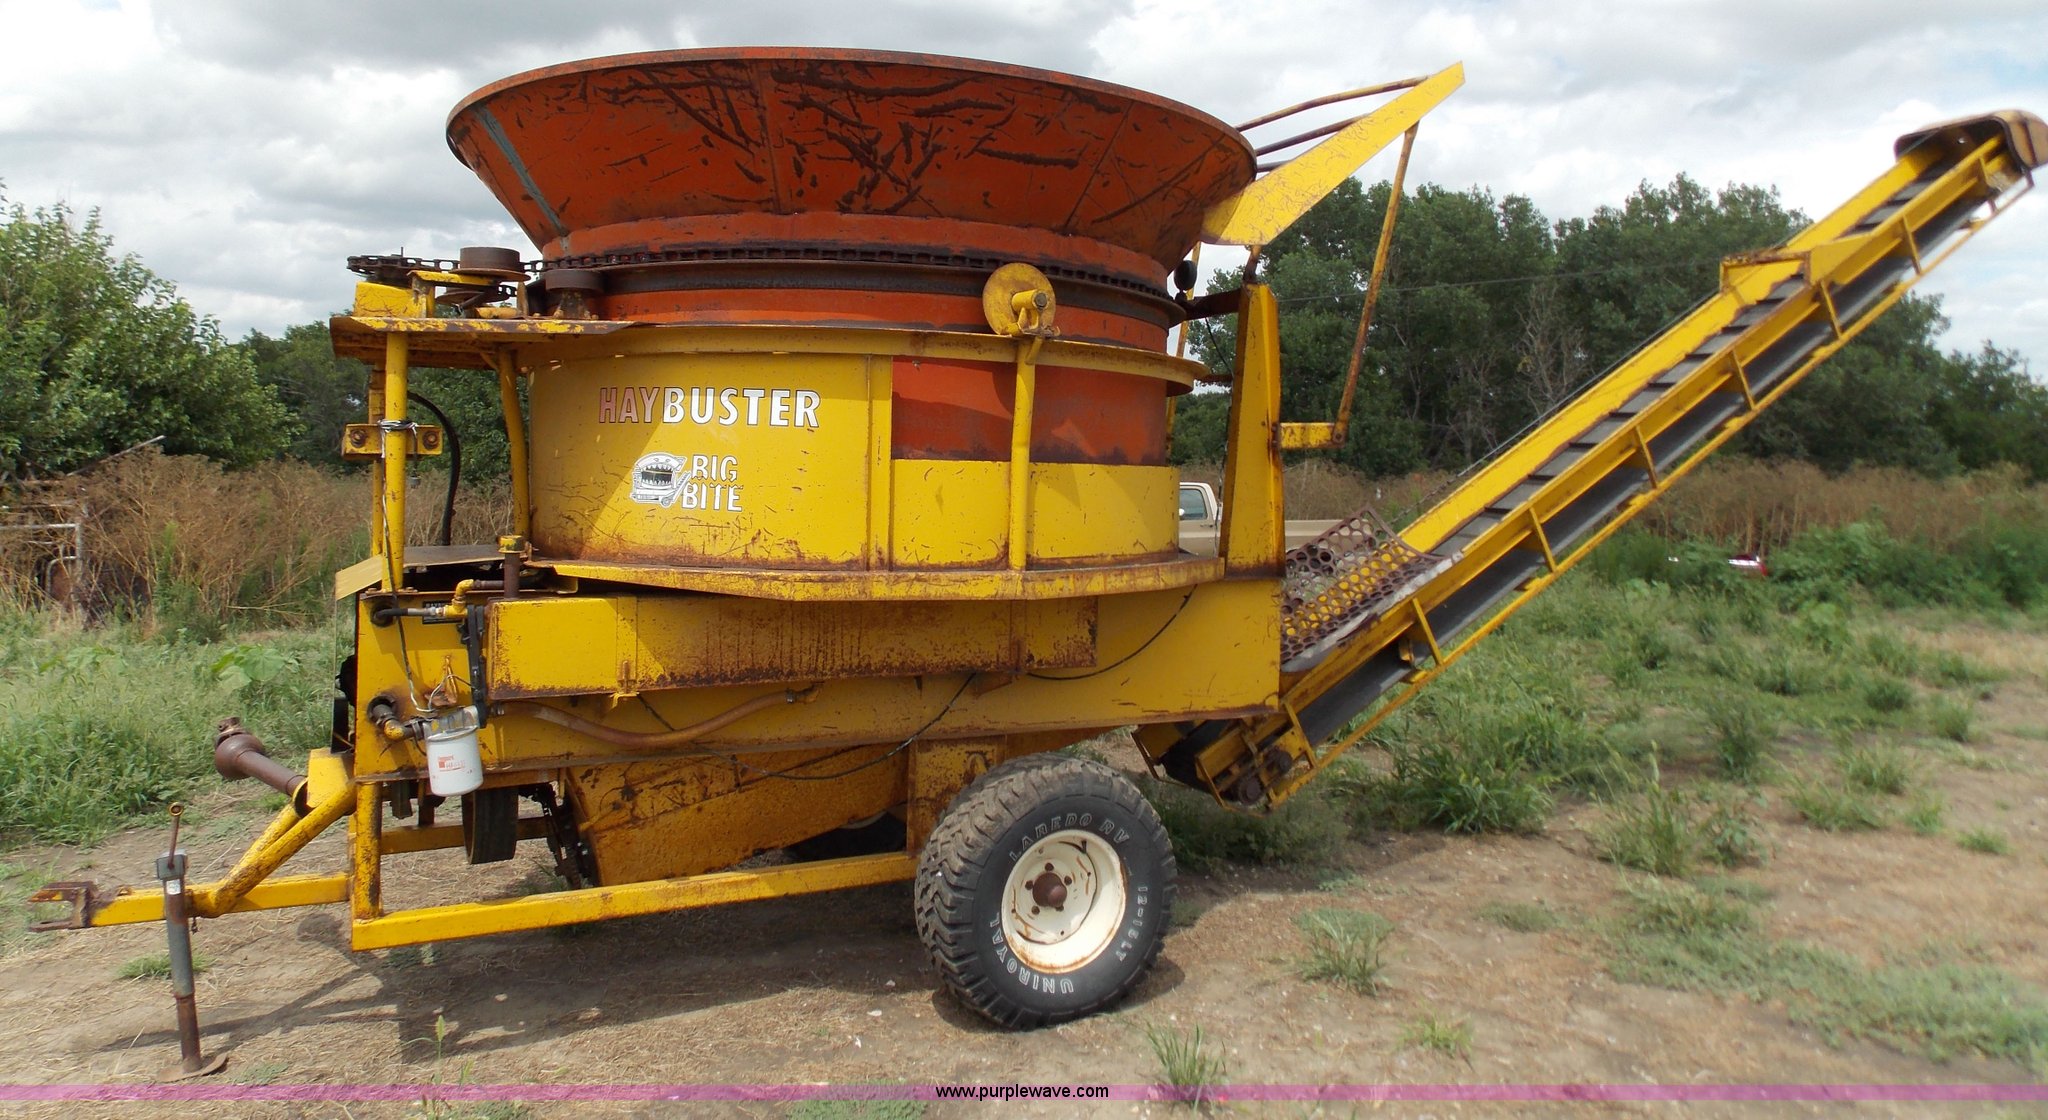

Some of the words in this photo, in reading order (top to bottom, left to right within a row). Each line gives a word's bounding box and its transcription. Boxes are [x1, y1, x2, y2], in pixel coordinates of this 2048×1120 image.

[599, 386, 821, 428] HAYBUSTER
[691, 454, 738, 482] BIG
[681, 482, 744, 512] BITE
[1009, 813, 1093, 862] LAREDO
[1099, 819, 1130, 845] RV
[989, 912, 1075, 994] UNIROYAL
